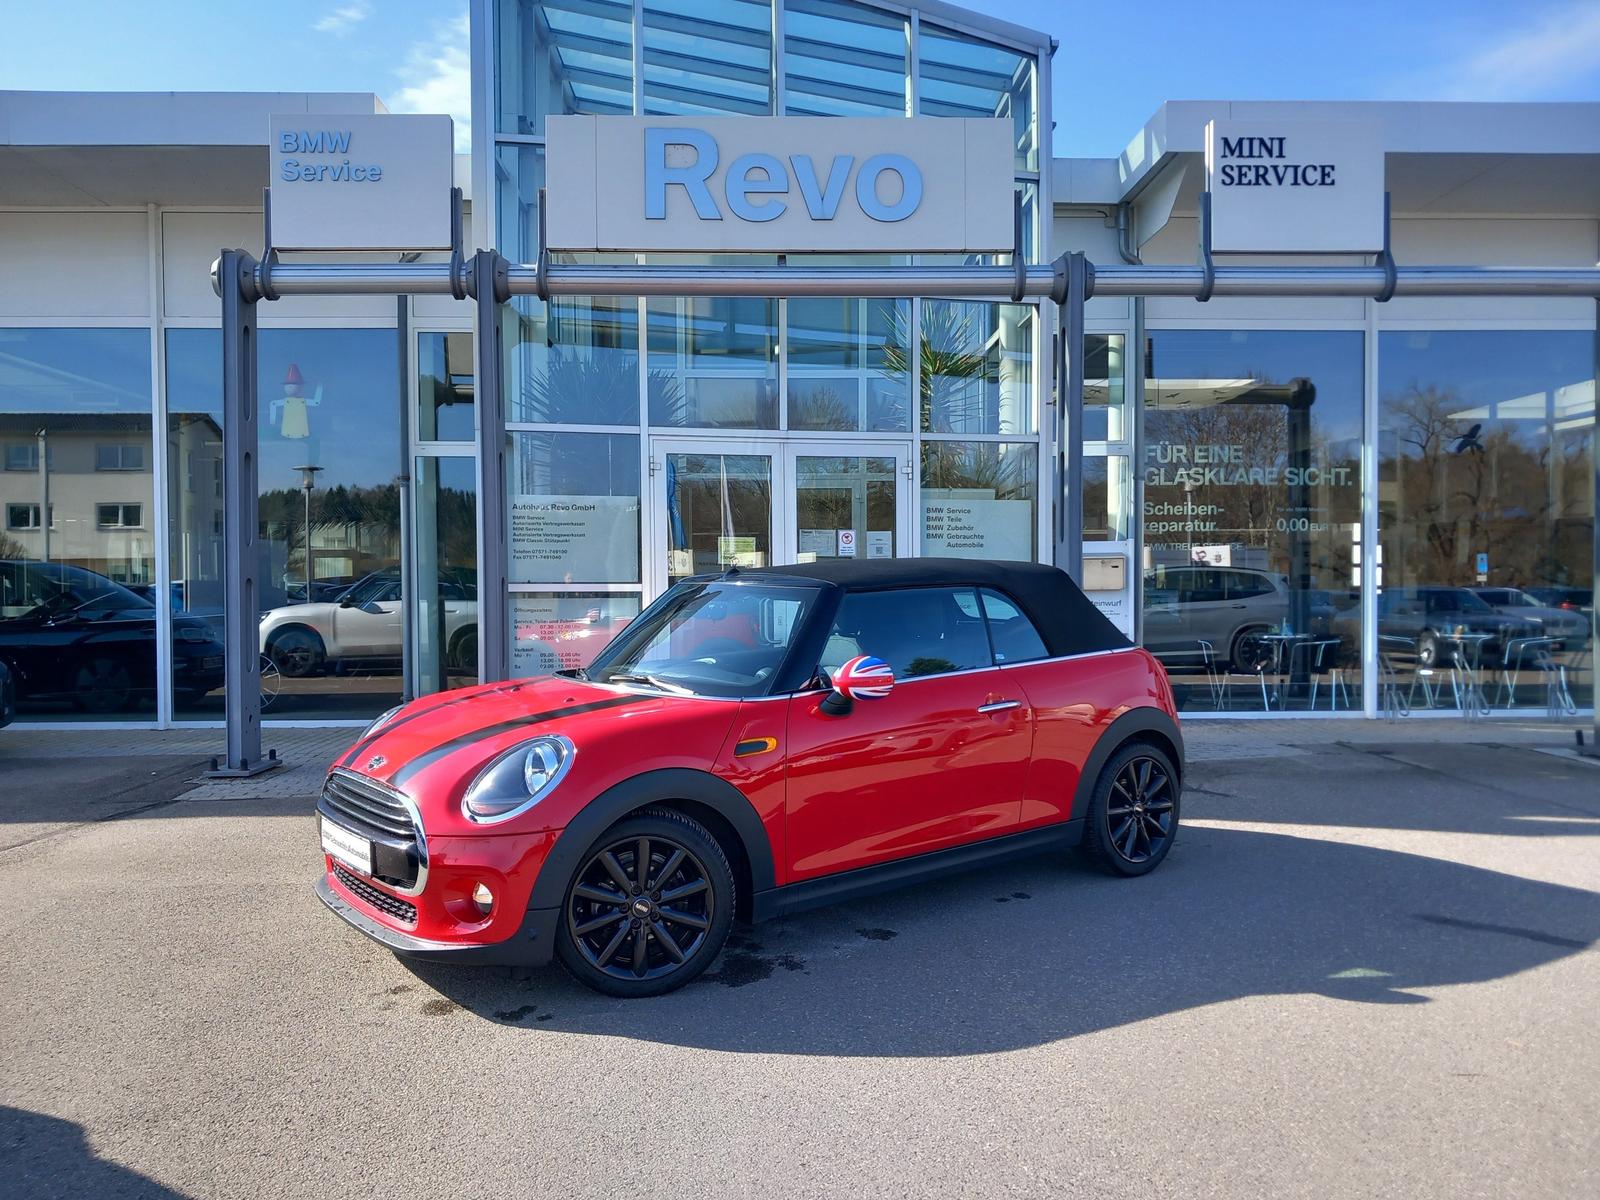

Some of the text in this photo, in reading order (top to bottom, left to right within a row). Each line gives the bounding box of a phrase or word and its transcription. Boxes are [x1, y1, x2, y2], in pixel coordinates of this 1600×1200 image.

[279, 130, 352, 154] BMW
[1221, 136, 1286, 160] MINI
[280, 159, 382, 183] Service
[644, 127, 923, 222] Revo
[1221, 164, 1336, 187] SERVICE
[1144, 441, 1243, 464] FÜR EINE
[1144, 467, 1352, 486] GLASKLARE SICHT.
[512, 504, 550, 512] Autohaus
[551, 504, 570, 512] Revo
[1143, 501, 1224, 516] Scheiben-
[1276, 518, 1308, 534] 0,00
